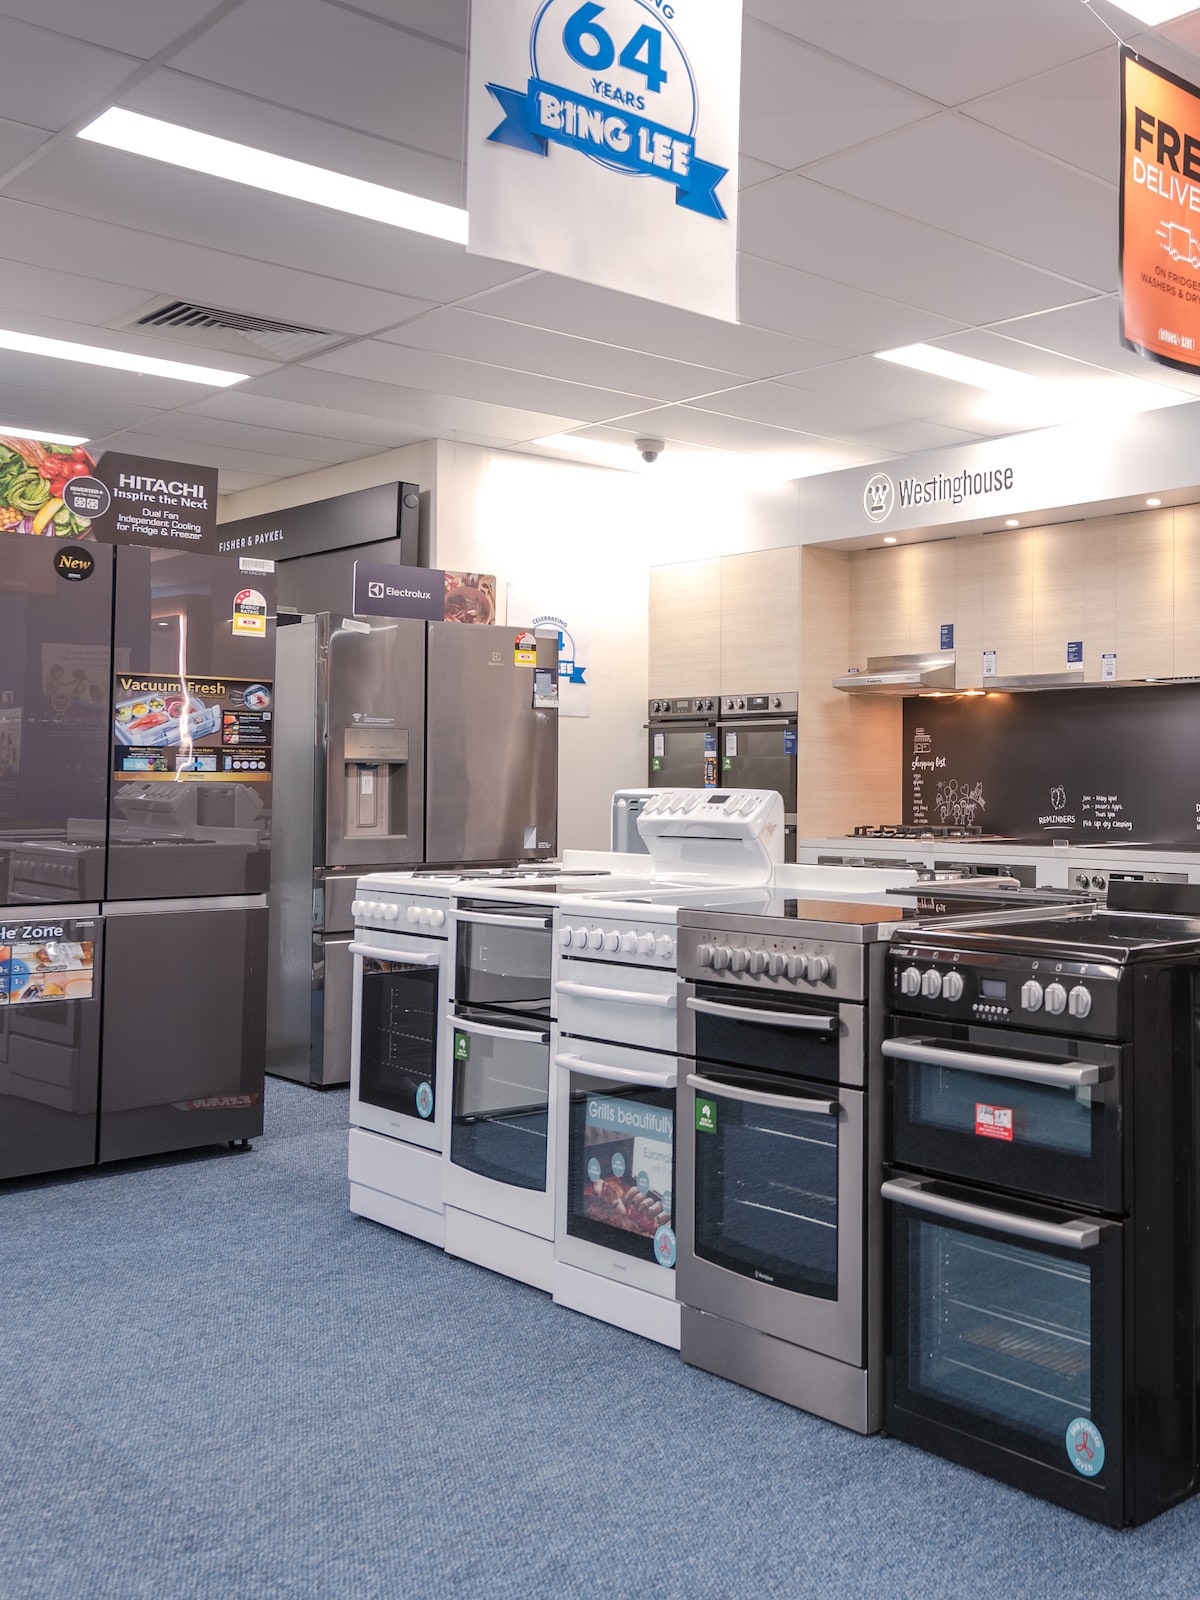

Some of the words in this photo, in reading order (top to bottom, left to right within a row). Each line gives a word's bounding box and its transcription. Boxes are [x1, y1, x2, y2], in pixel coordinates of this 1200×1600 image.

[562, 1, 667, 93] 64
[590, 78, 645, 110] YEARS
[536, 91, 632, 153] BING
[638, 126, 692, 176] LEE
[1155, 265, 1167, 278] ON
[1140, 272, 1176, 298] WASHERS
[1178, 289, 1184, 299] &
[119, 473, 204, 498] HITACHI
[899, 467, 1013, 507] Westinghouse
[113, 488, 156, 502] Inspire
[159, 494, 178, 505] the
[180, 497, 208, 510] Next
[118, 513, 170, 528] Independent
[171, 520, 201, 533] Cooling
[142, 508, 161, 518] Dual
[164, 511, 179, 520] Fan
[116, 522, 130, 531] for
[131, 525, 158, 536] Fridge
[160, 528, 168, 536] &
[170, 529, 202, 540] Freezer
[218, 538, 245, 552] FISHER
[247, 536, 253, 546] &
[255, 530, 284, 545] PAYKEL
[58, 554, 92, 570] New
[386, 586, 431, 600] Electrolux
[532, 616, 568, 628] CELEBRATING
[120, 678, 182, 692] Vacuum
[187, 682, 226, 695] Fresh
[1038, 815, 1076, 825] REMINDERS
[22, 926, 63, 939] Zone
[589, 1101, 615, 1121] Grills
[617, 1107, 673, 1138] beautifully
